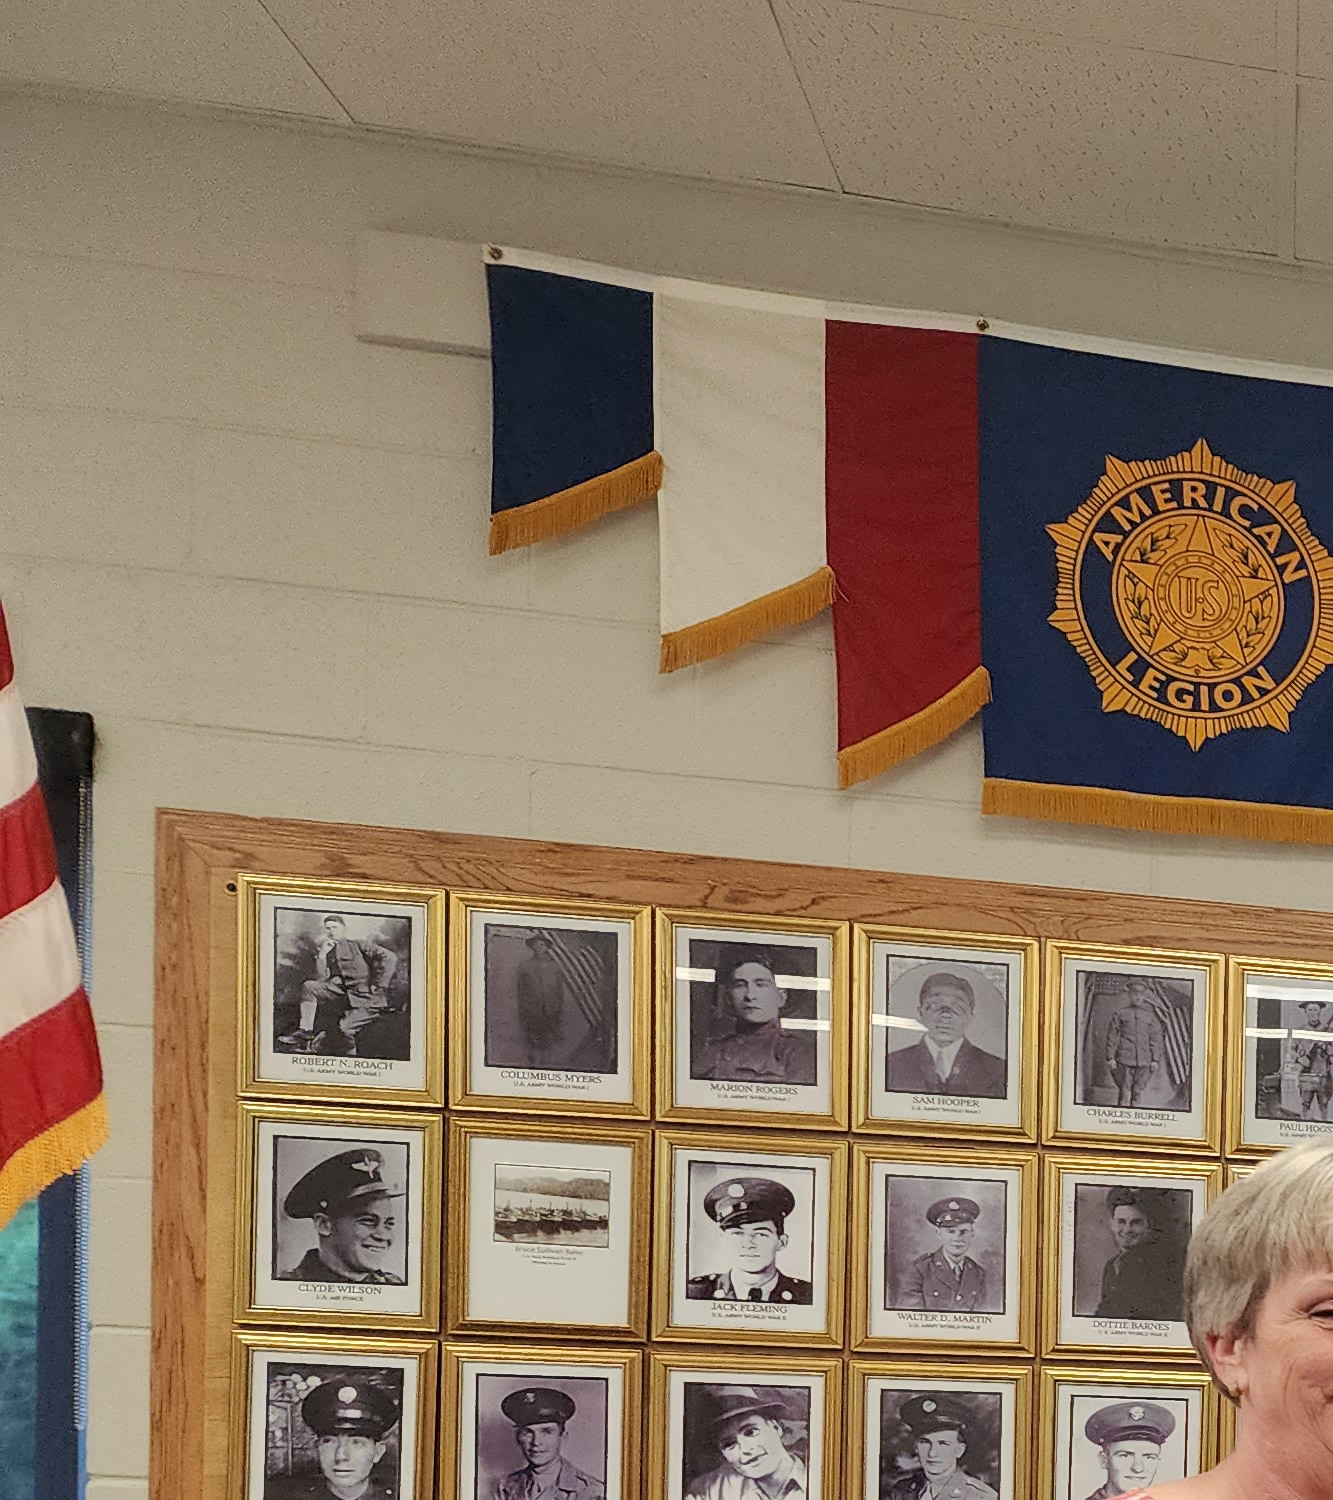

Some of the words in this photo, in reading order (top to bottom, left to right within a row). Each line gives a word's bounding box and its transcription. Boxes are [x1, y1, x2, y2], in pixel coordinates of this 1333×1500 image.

[1093, 480, 1309, 584] AMERICAN
[1114, 651, 1277, 711] LEGION
[291, 1057, 336, 1067] ROBERT
[339, 1059, 351, 1068] N.
[354, 1060, 393, 1070] ROACH
[500, 1070, 562, 1082] COLUMBUS
[565, 1074, 602, 1084] MYERS
[710, 1083, 753, 1093] MARION
[756, 1085, 798, 1095] ROGERS
[912, 1095, 935, 1105] SAM
[937, 1097, 980, 1107] HOOPER
[1086, 1108, 1132, 1119] CHARLES
[1279, 1122, 1305, 1132] PAUL
[298, 1283, 335, 1293] CLYDE
[337, 1285, 382, 1295] WILSON
[711, 1302, 737, 1311] JACK
[740, 1304, 787, 1314] FLEMING
[897, 1312, 938, 1322] WALTER
[953, 1315, 992, 1324] MARTIN
[1093, 1320, 1129, 1329] DOTTIE
[1131, 1322, 1170, 1331] BARNES
